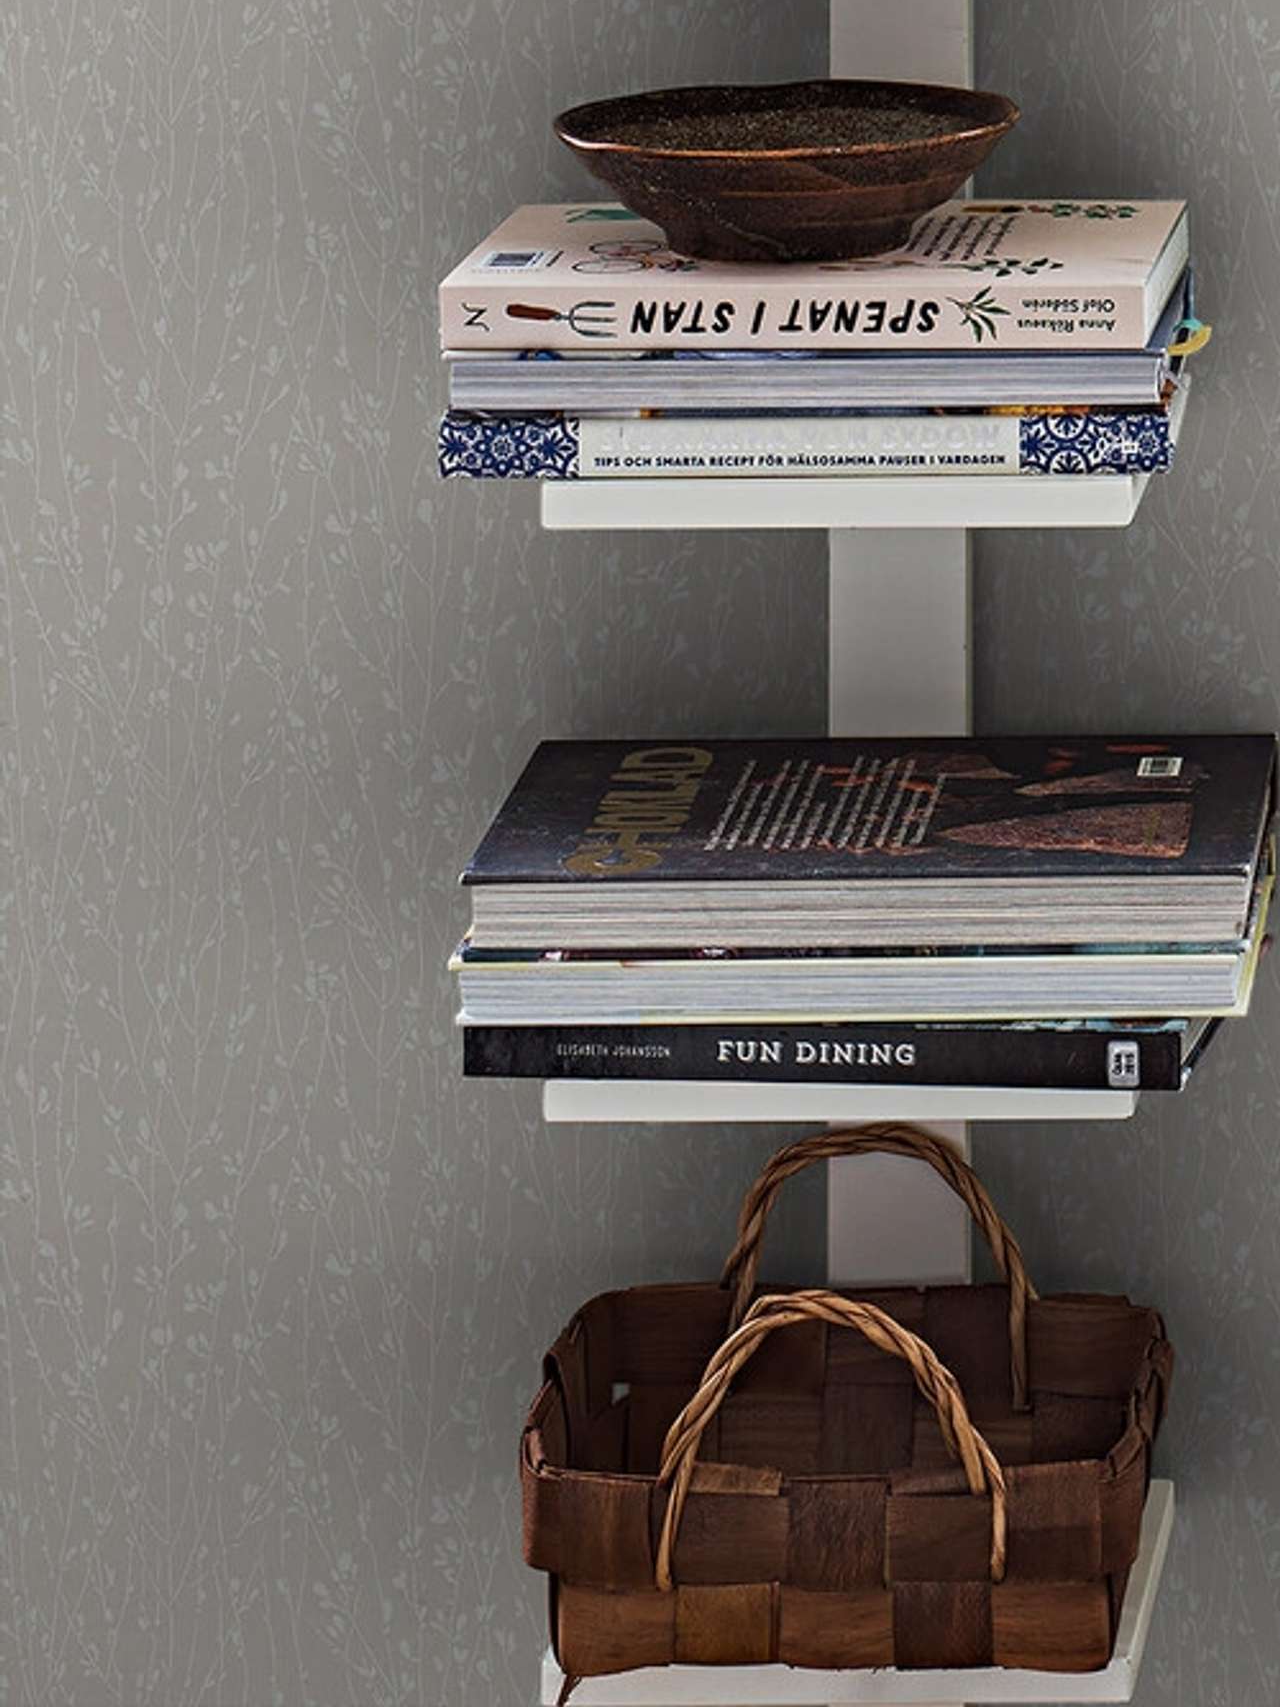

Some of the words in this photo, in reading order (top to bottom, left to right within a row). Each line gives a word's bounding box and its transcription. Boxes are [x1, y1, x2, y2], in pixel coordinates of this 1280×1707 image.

[630, 299, 735, 334] STAN
[750, 300, 766, 334] I
[778, 298, 940, 333] SPENAT
[1082, 299, 1116, 313] Olof
[1079, 319, 1116, 332] Anna
[594, 456, 621, 467] TIPS
[624, 456, 652, 467] OCH
[656, 455, 706, 467] SMARTA
[709, 455, 755, 467] RECEPT
[757, 452, 784, 467] FÖR
[787, 451, 877, 467] HÄLSOSAMMA
[879, 454, 926, 466] PAUSER
[937, 454, 1006, 466] VARDAGEN
[562, 746, 714, 875] CHOKLAD
[716, 1040, 783, 1063] FUN
[795, 1041, 916, 1066] DINING
